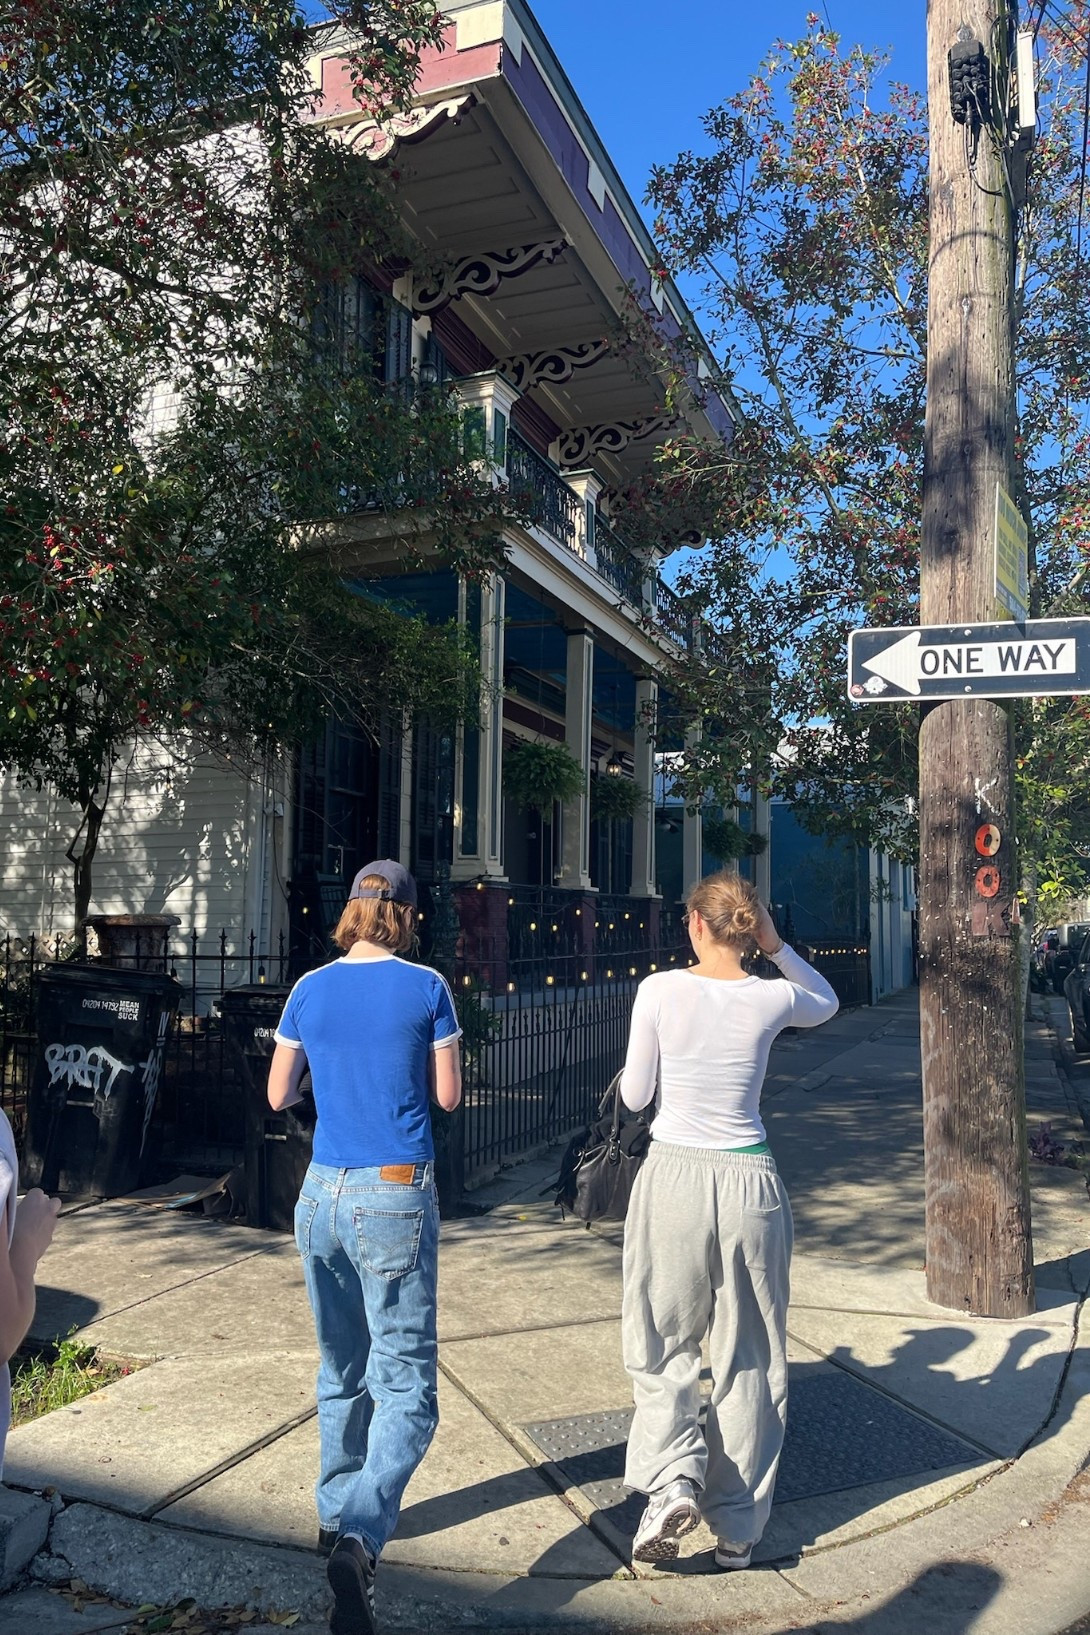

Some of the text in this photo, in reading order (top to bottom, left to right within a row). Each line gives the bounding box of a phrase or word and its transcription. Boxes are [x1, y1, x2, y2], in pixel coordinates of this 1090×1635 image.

[920, 643, 1067, 676] ONE WAY
[119, 1000, 140, 1009] MEAN
[118, 1006, 139, 1014] PEOPLE
[117, 1012, 138, 1021] SUCK
